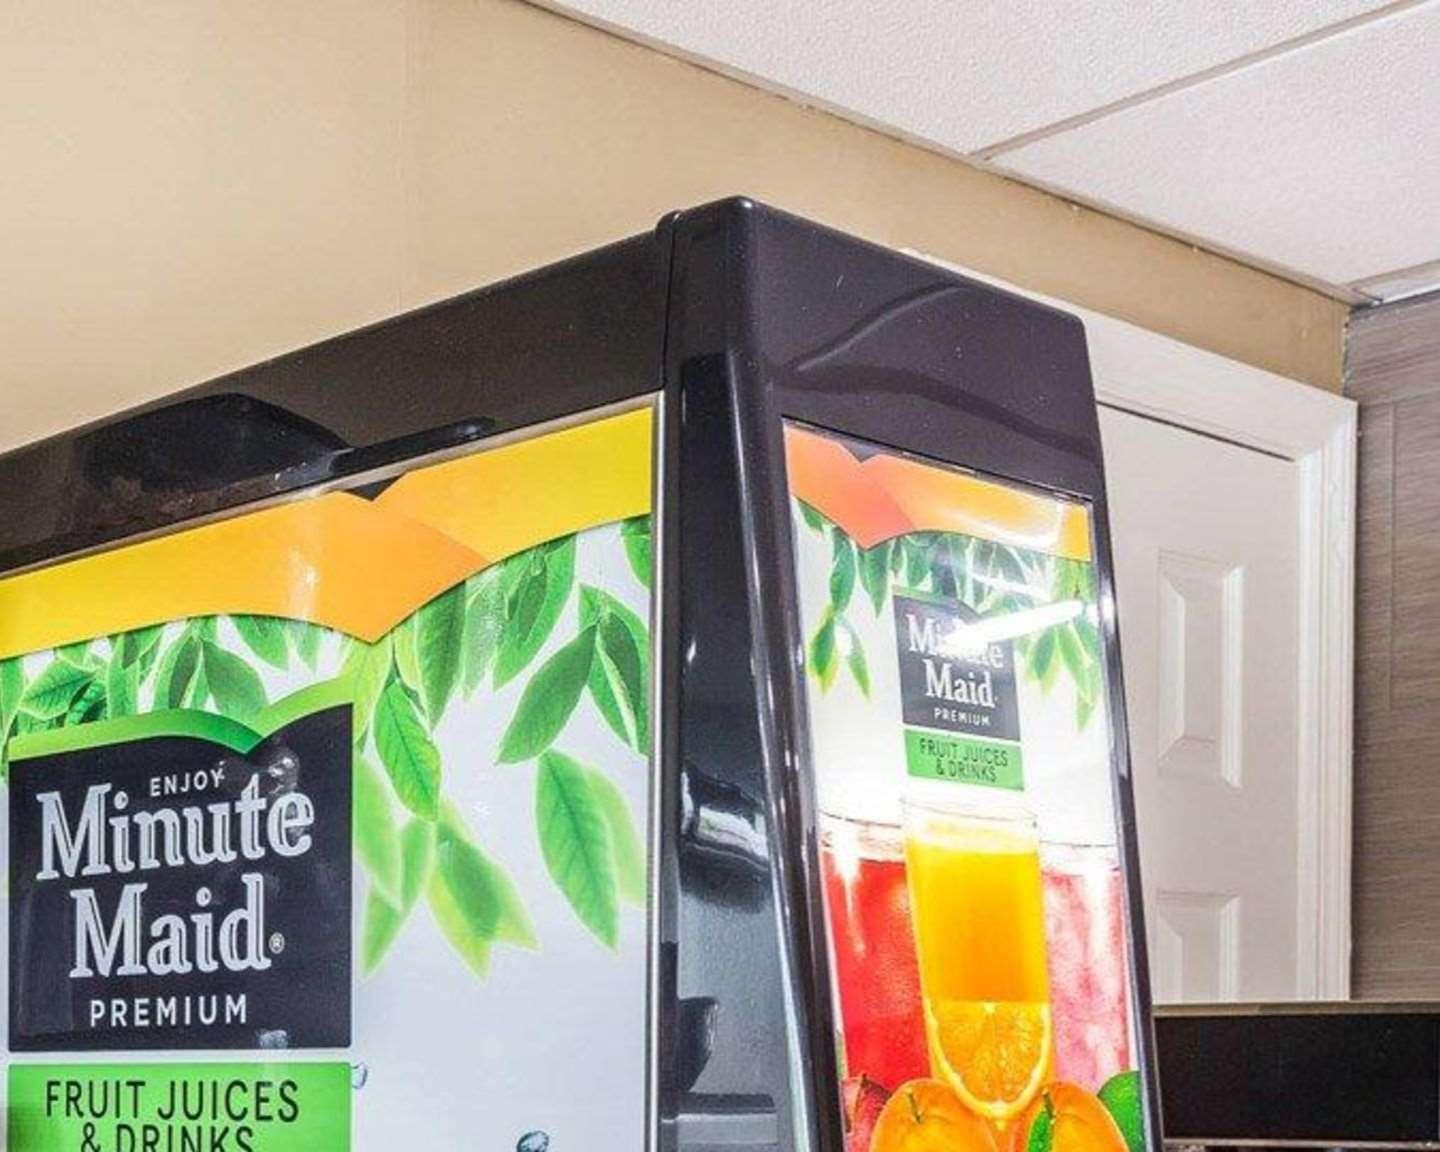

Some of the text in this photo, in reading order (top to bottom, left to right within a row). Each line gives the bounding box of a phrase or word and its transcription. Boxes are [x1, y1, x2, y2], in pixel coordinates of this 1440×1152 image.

[934, 707, 991, 726] PREMIUM
[920, 737, 1009, 767] FRUIT JUICES
[150, 765, 225, 797] ENJOY
[948, 760, 997, 782] DRINKS
[36, 774, 315, 881] Minute
[90, 993, 248, 1028] PREMIUM
[46, 1079, 299, 1124] FRUIT JUICES
